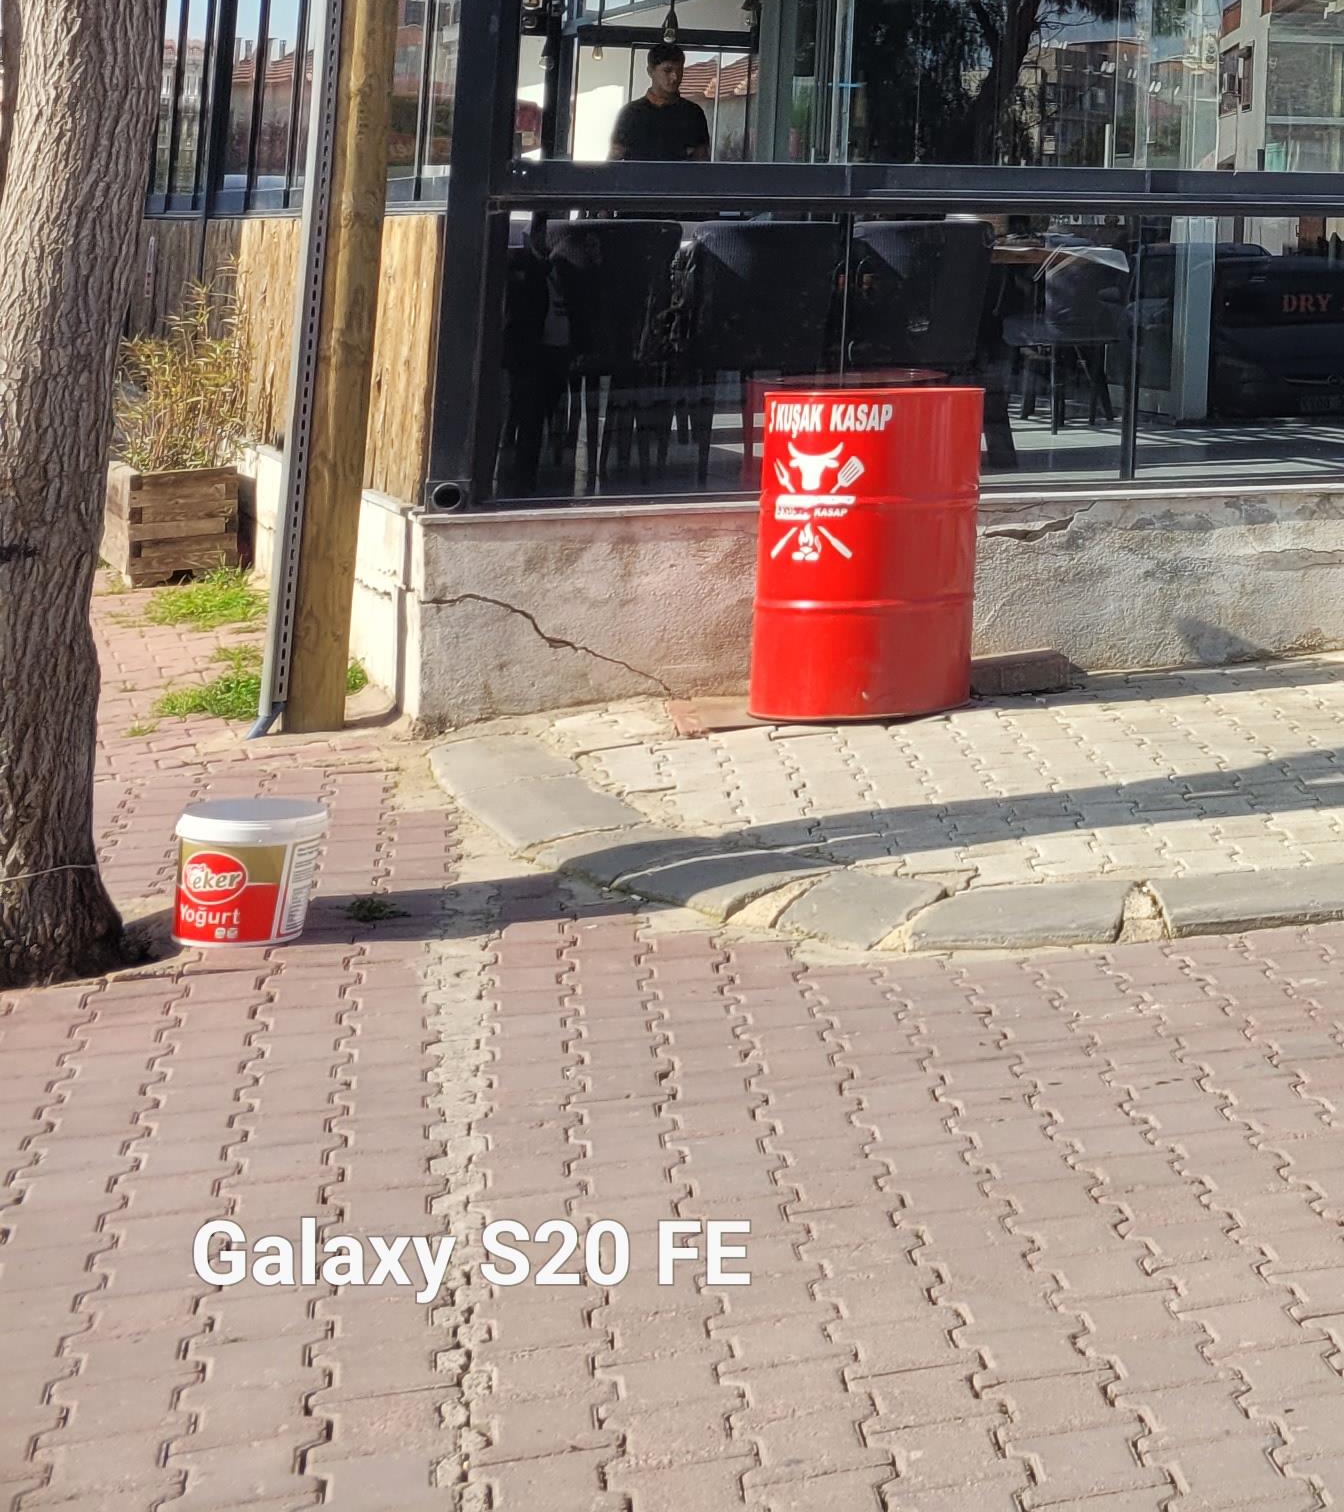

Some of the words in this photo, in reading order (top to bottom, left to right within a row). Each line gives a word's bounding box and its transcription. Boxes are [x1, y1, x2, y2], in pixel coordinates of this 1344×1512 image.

[1281, 293, 1332, 313] DRY
[775, 402, 824, 438] KUŞAK
[828, 402, 894, 433] KASAP
[813, 507, 849, 518] KASAP
[180, 903, 241, 928] Yoğurt
